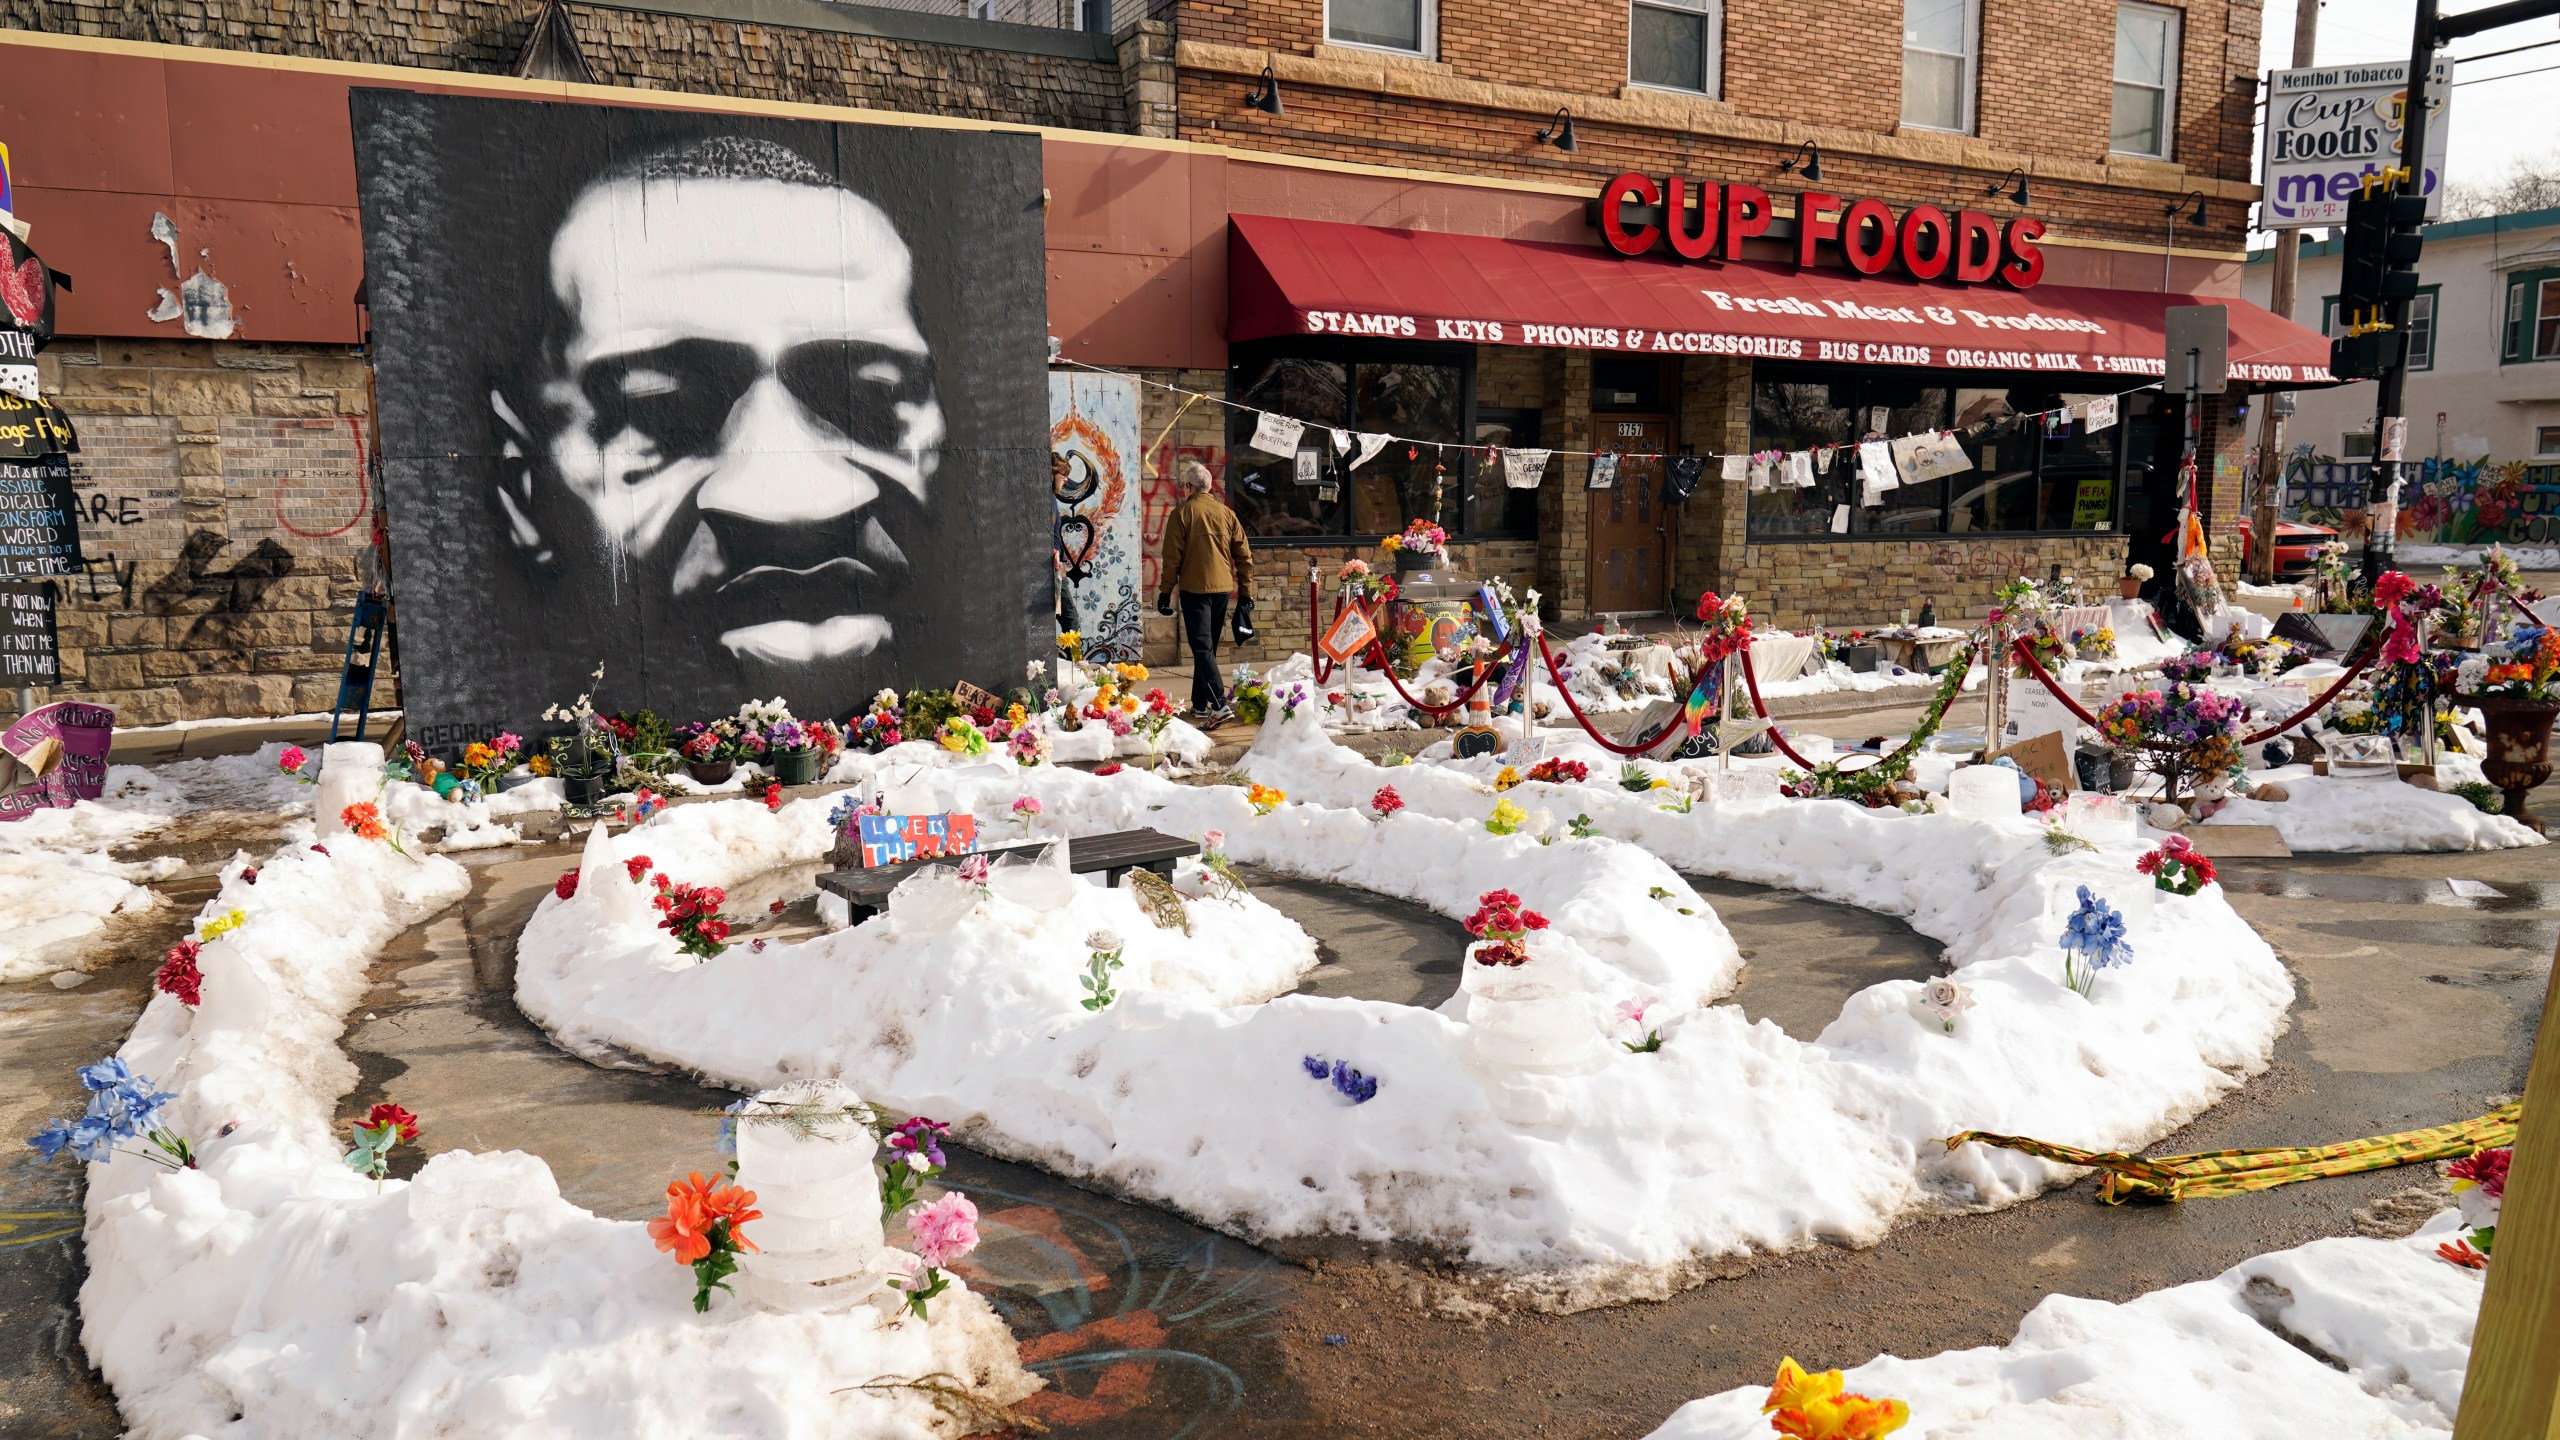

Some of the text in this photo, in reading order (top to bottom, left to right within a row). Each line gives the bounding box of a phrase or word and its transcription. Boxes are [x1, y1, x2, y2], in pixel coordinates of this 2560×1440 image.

[2282, 67, 2403, 88] Menthol Tobacco
[2287, 92, 2375, 131] Cup
[2275, 125, 2379, 159] Foods
[2278, 163, 2437, 202] meto
[2302, 205, 2319, 221] by
[1601, 172, 2046, 289] CUP FOODS
[1701, 290, 2107, 334] Fresh Meat & Produce
[1307, 311, 1417, 336] STAMPS
[1436, 319, 1503, 341] KEYS
[1522, 324, 1619, 348] PHONES
[1625, 329, 1645, 349] &
[1652, 331, 1802, 358] ACCESSORIES
[1819, 341, 1859, 361] BUS
[1864, 344, 1930, 365] CARDS
[1946, 349, 2032, 369] ORGANIC
[2035, 353, 2082, 370] MILK
[2093, 355, 2166, 375] T-SHIRTS
[2227, 363, 2249, 379] AN
[2253, 364, 2292, 380] FOOD
[34, 417, 73, 445] Floyd
[1619, 423, 1643, 436] 3757
[4, 465, 20, 478] ACT
[40, 467, 47, 478] IT
[2287, 461, 2424, 485] ABOLH
[0, 480, 46, 493] SSIBLe
[2080, 486, 2106, 498] WE FIX
[2078, 499, 2107, 511] PHONES
[3, 528, 58, 544] WORLD
[1, 593, 52, 611] IF NOT NOW
[3, 635, 12, 650] IF
[15, 635, 36, 651] NOT
[2031, 700, 2049, 709] NOW!
[1686, 731, 1718, 756] Joy
[872, 817, 945, 836] LOVE IS
[865, 840, 915, 866] THE
